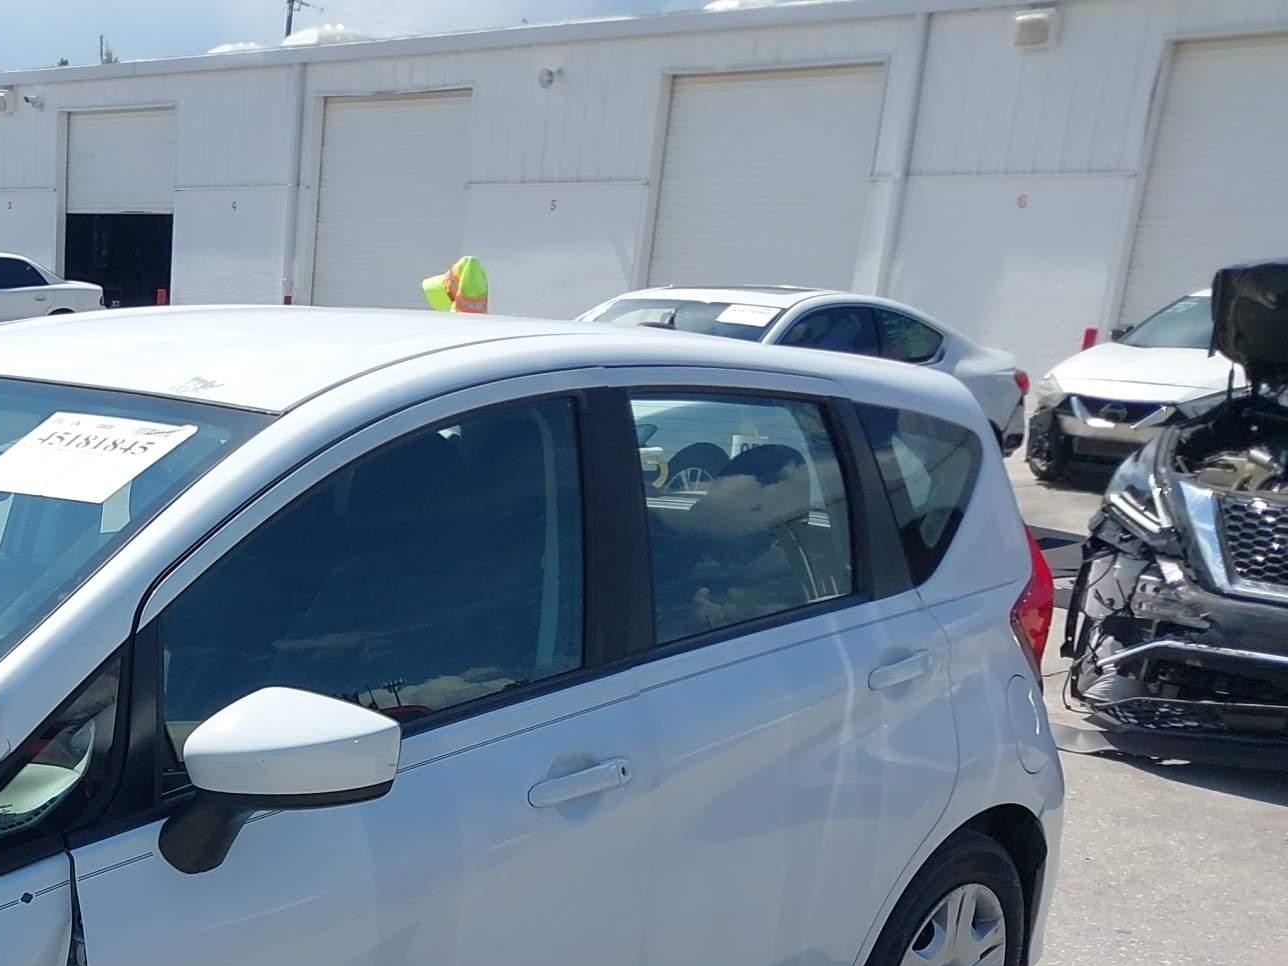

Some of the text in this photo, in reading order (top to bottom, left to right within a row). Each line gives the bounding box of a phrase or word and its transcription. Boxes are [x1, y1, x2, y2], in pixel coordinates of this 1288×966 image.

[549, 198, 558, 212] 5
[1017, 193, 1029, 209] 6
[38, 431, 156, 456] 45181845
